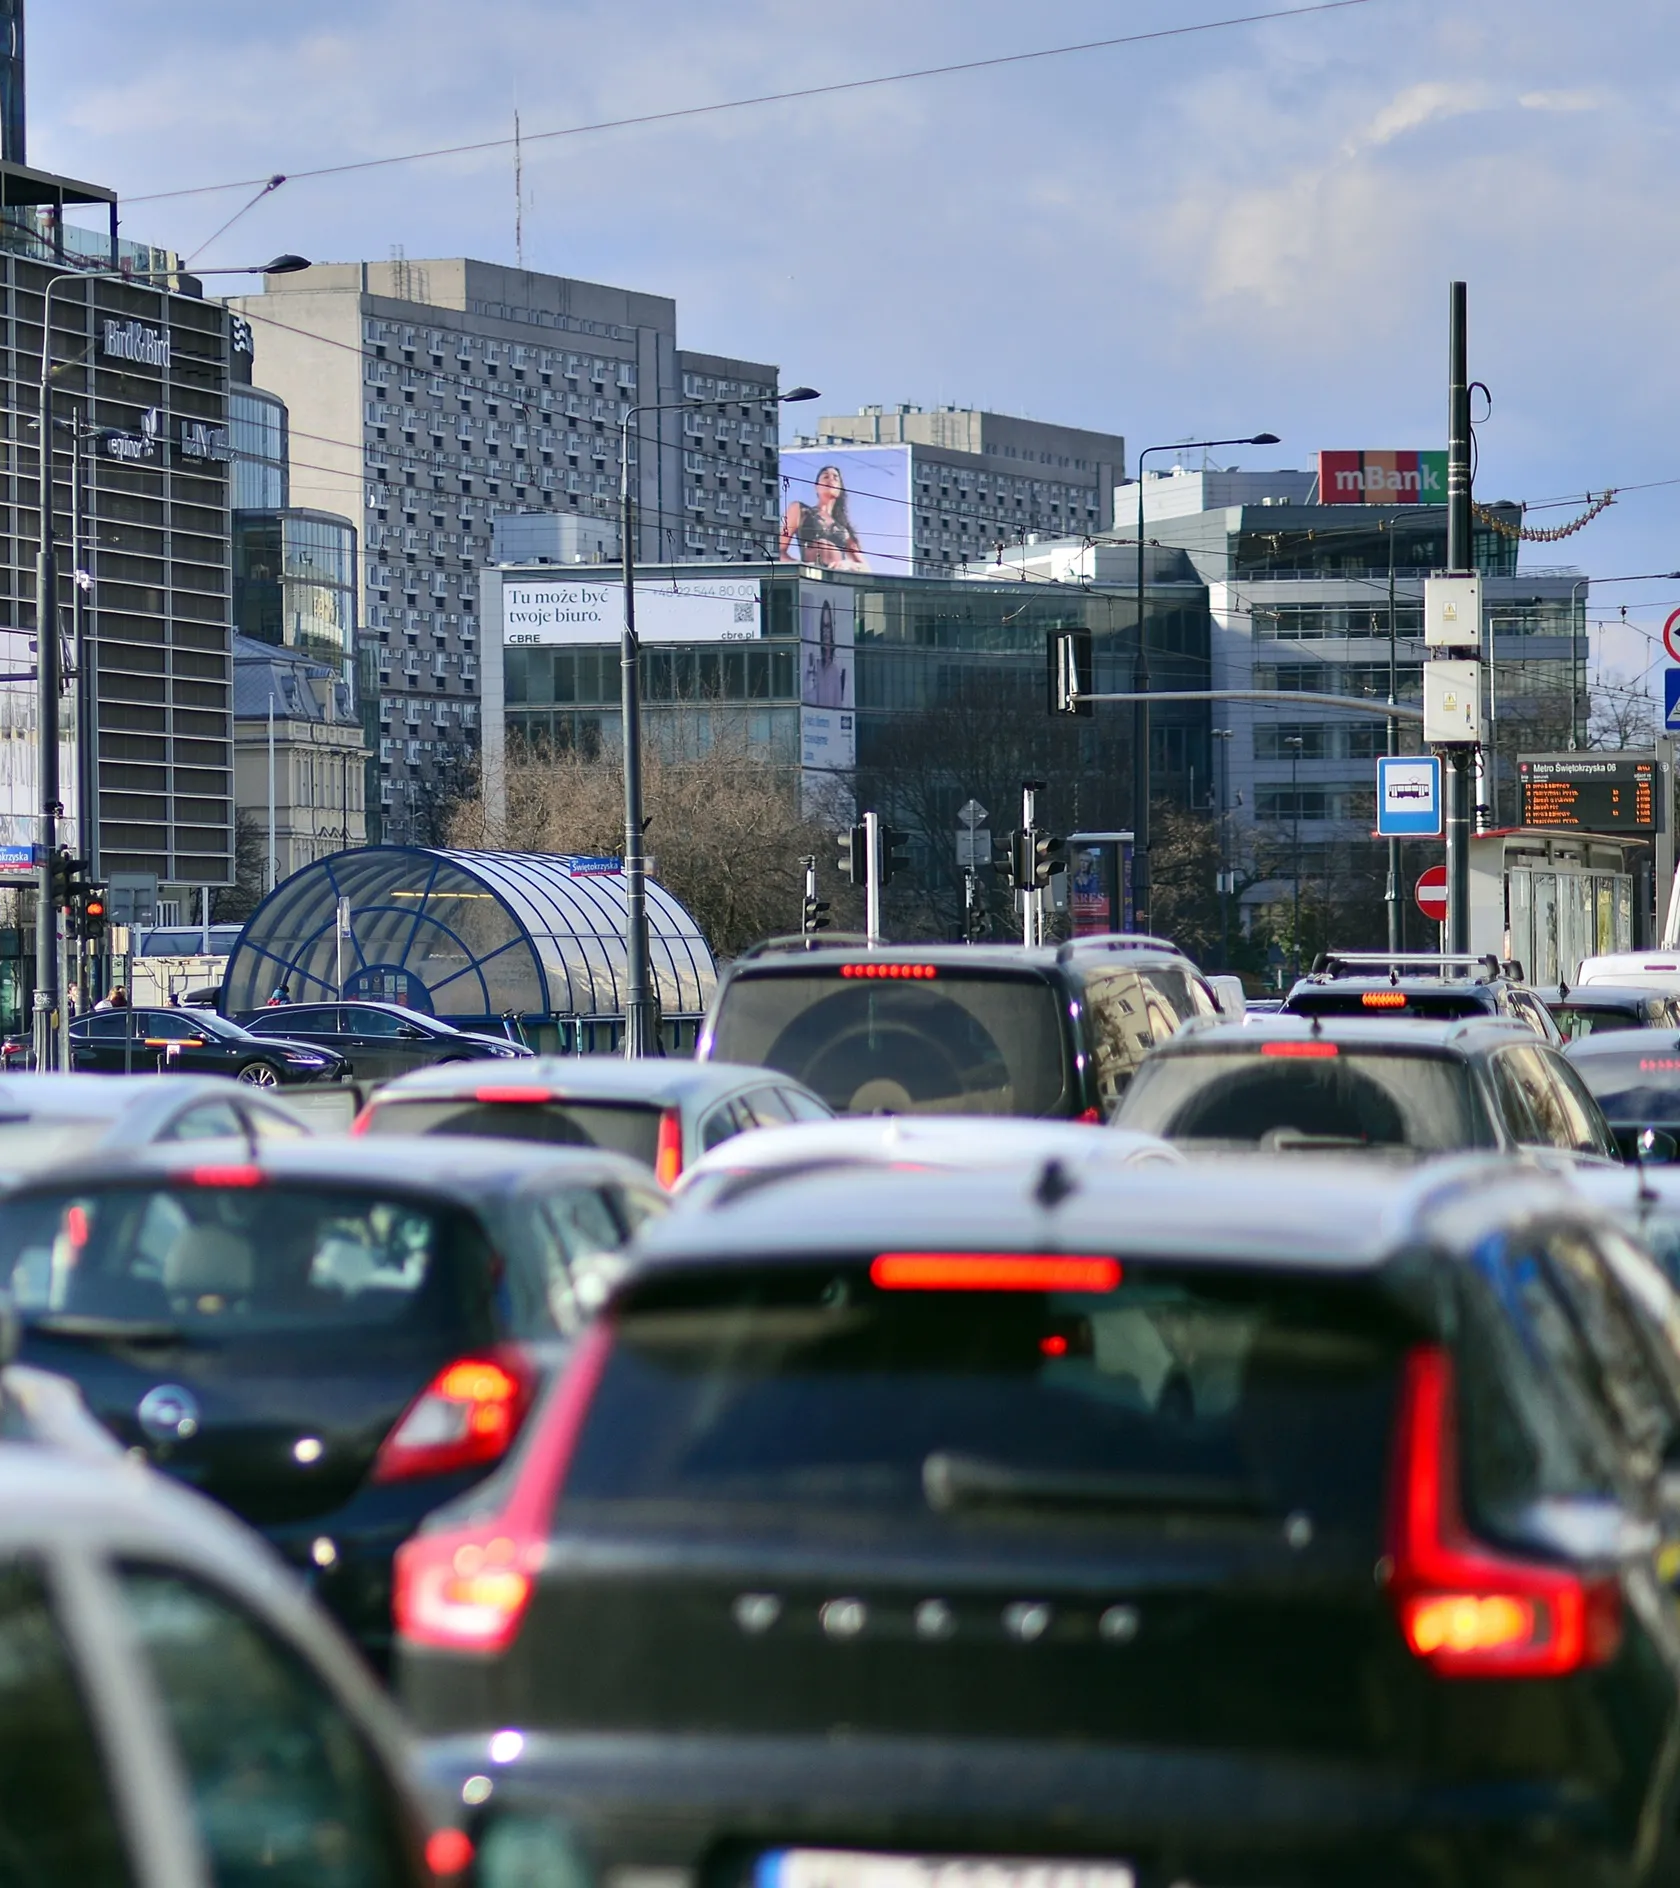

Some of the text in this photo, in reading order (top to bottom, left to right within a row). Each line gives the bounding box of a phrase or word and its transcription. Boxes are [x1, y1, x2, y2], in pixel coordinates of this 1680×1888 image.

[103, 319, 171, 368] Bird&Bird
[107, 438, 143, 461] equinor
[1334, 464, 1441, 490] mBank
[508, 588, 609, 606] Tu może być
[719, 585, 735, 597] 80
[737, 585, 754, 597] 00
[509, 608, 601, 626] twoje biuro.
[509, 634, 541, 643] CBRE
[721, 630, 755, 641] cbre.pl
[1533, 763, 1554, 773] Metro
[1555, 762, 1605, 774] Świętokrzyska
[572, 862, 619, 872] Świętokrzyska
